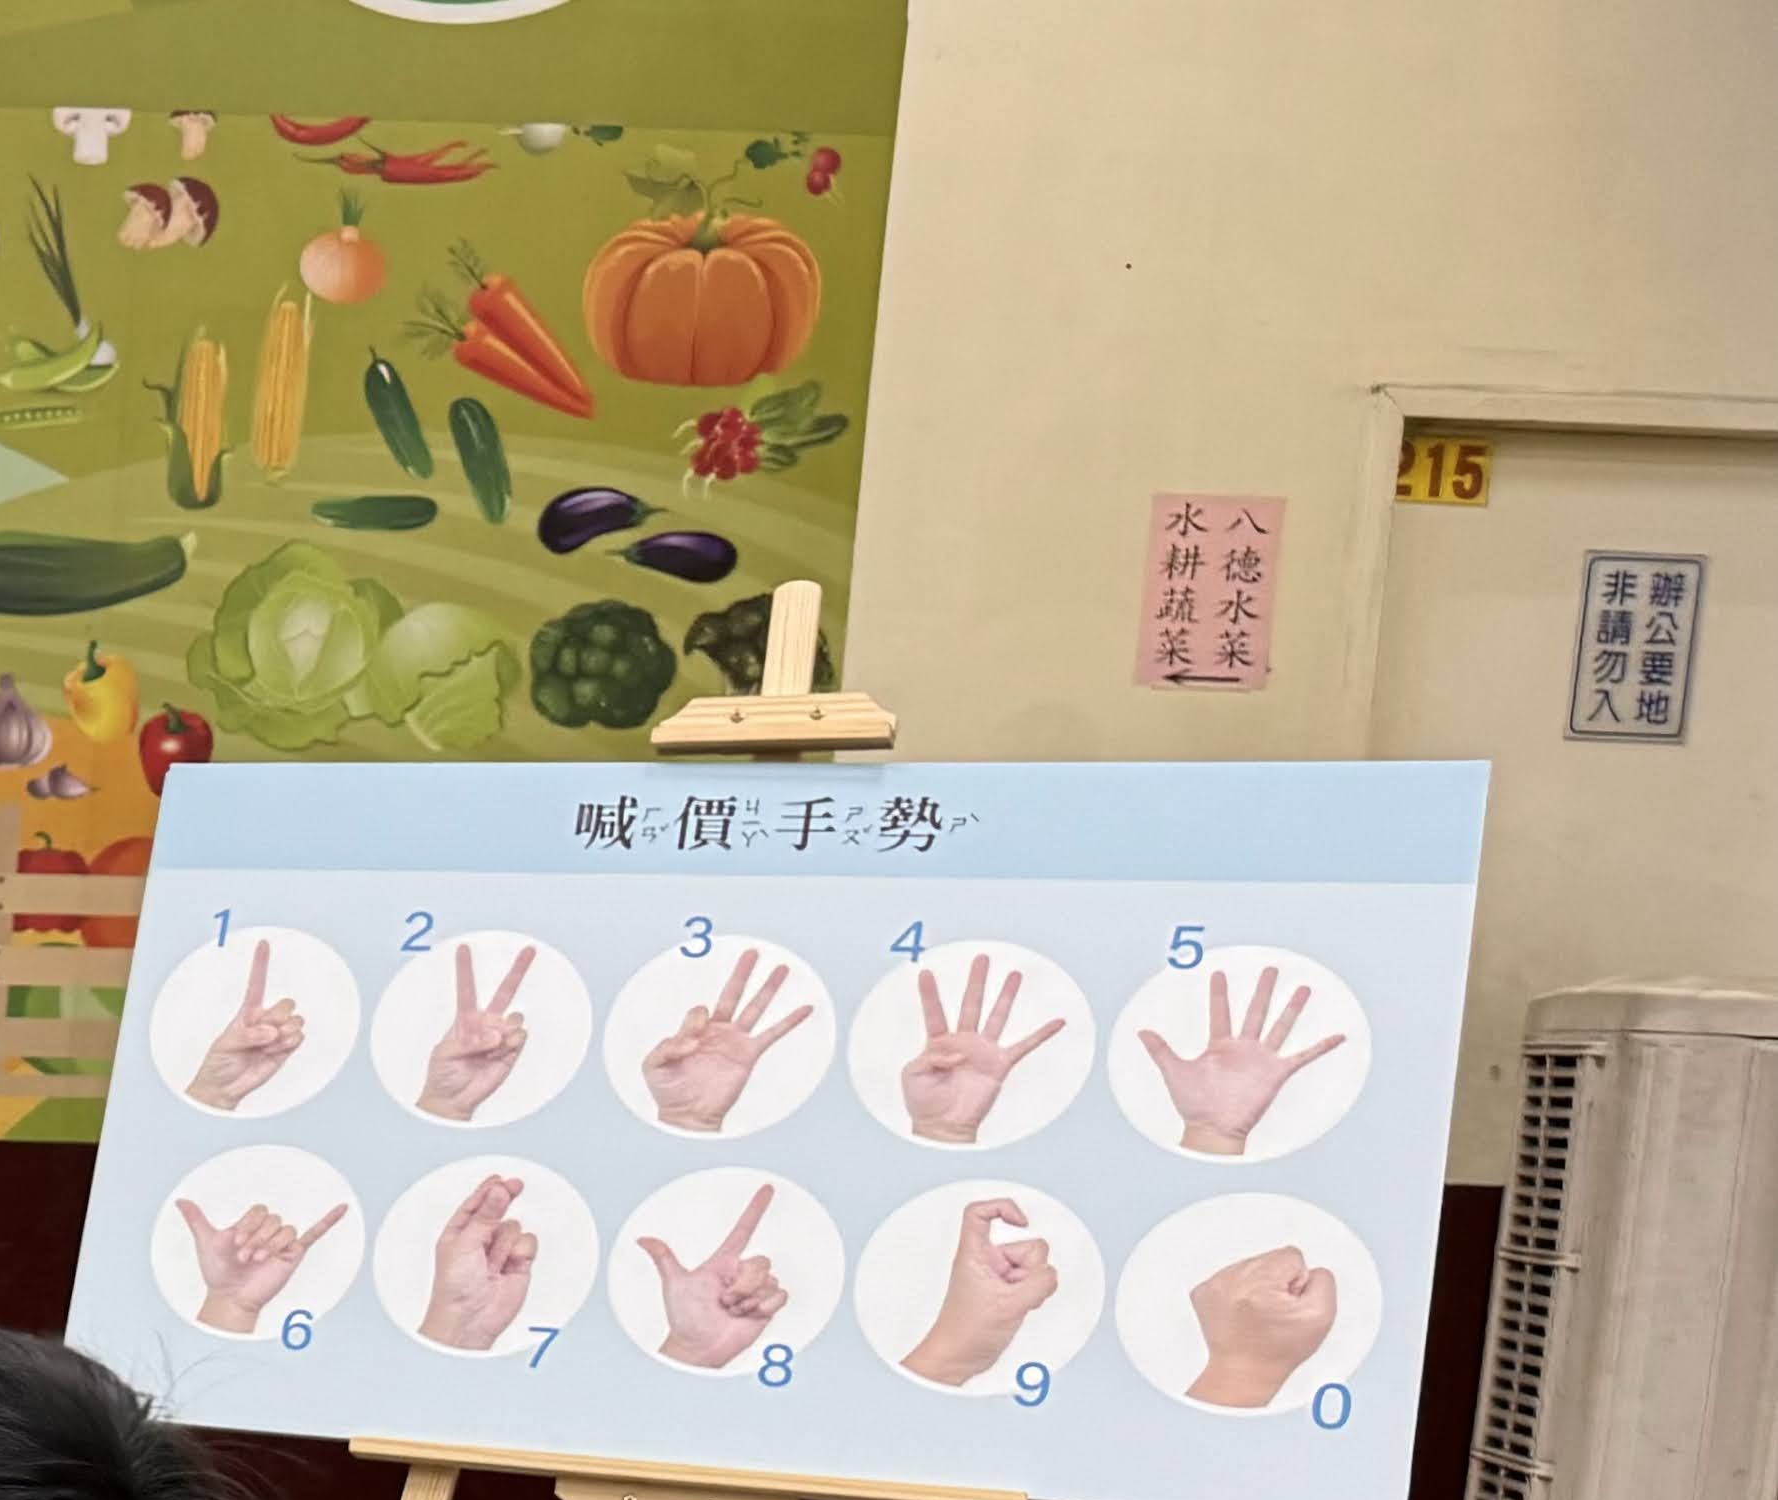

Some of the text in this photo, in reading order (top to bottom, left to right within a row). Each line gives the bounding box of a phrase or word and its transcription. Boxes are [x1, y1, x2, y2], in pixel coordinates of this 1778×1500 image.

[1153, 501, 1209, 667] 水耕蔬菜
[1213, 507, 1270, 669] 八德水菜
[1587, 570, 1638, 723] 非請勿入
[1634, 571, 1686, 725] 辦公要地
[574, 795, 944, 853] 喊價手勢
[214, 909, 231, 947] 1
[400, 911, 435, 952] 2
[679, 915, 714, 958] 3
[890, 920, 926, 963] 4
[1167, 925, 1206, 970] 5
[281, 1309, 314, 1351] 6
[527, 1327, 560, 1369] 7
[757, 1344, 795, 1388] 8
[1013, 1361, 1051, 1408] 9
[1311, 1382, 1352, 1430] 0
